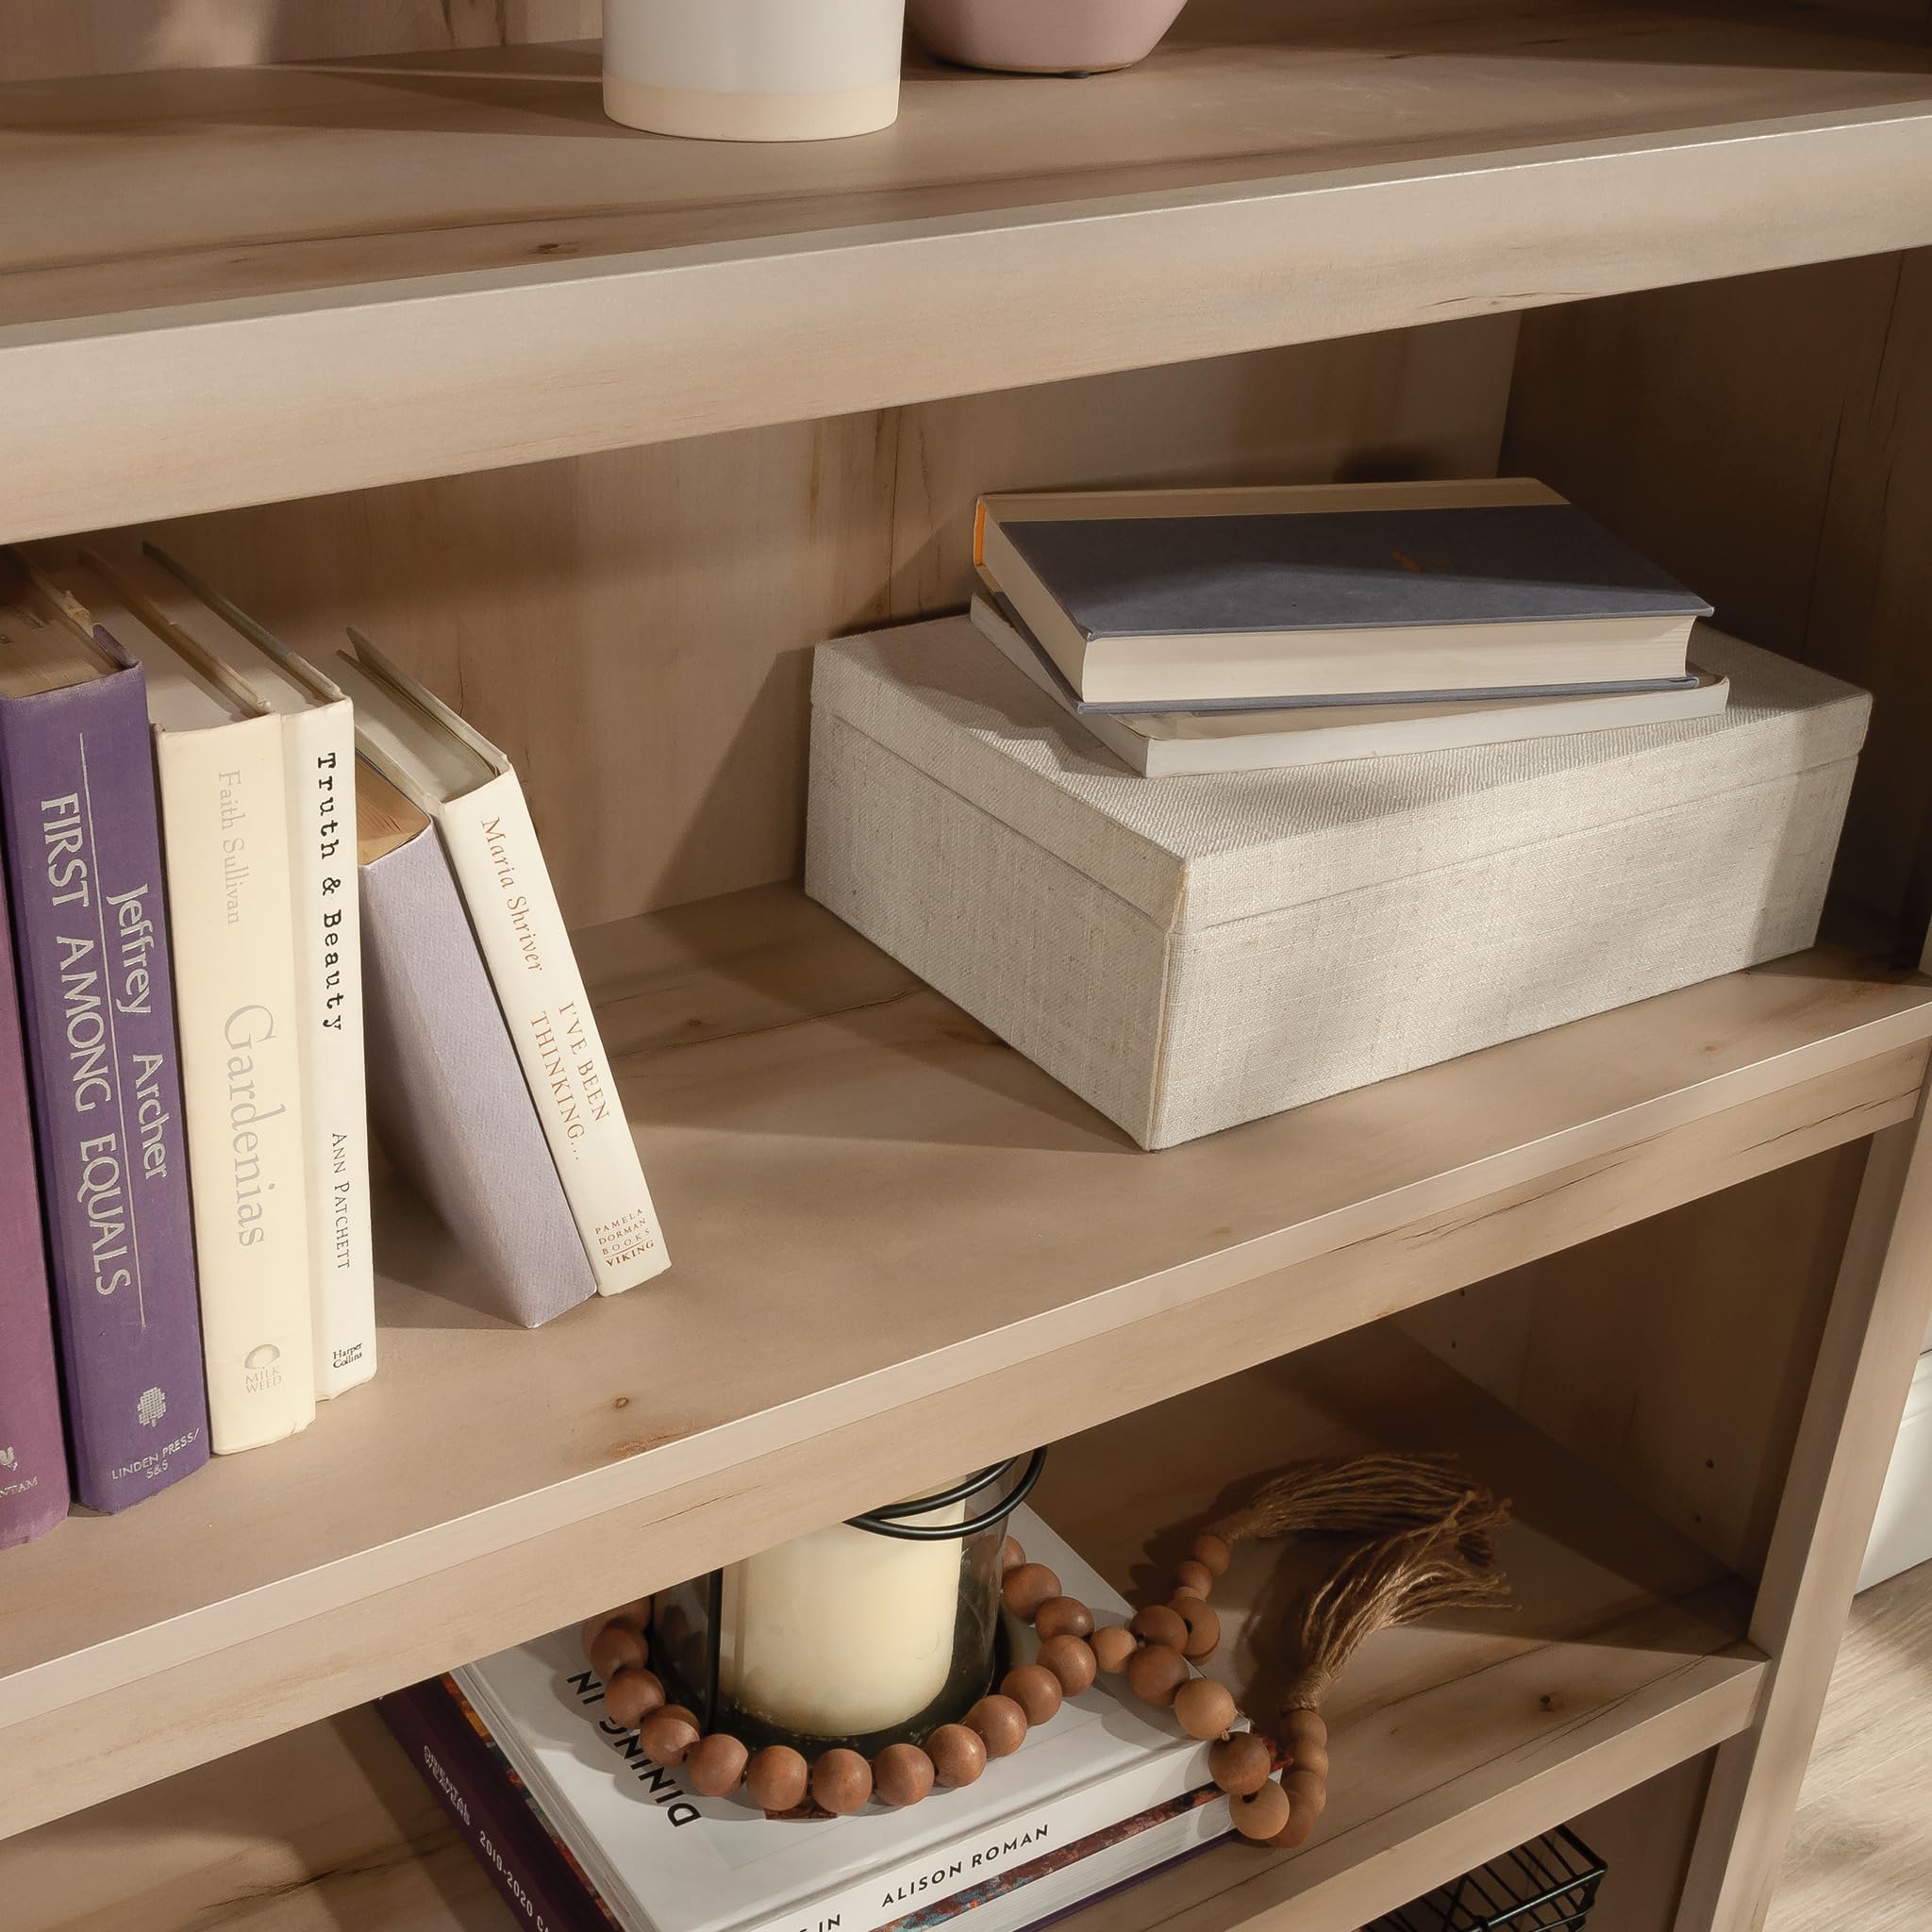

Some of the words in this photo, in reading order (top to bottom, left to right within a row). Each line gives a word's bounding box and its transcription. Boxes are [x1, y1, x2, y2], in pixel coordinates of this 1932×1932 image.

[218, 770, 246, 830] Faith
[318, 752, 339, 859] Truth
[41, 792, 90, 907] FIRST
[223, 837, 249, 924] Sullivan
[322, 876, 341, 896] &
[480, 817, 515, 890] Maria
[507, 895, 544, 973] Shriver
[323, 909, 344, 1030] Beauty
[57, 936, 111, 1113] AMONG
[106, 883, 154, 1014] Jeffrey
[132, 1053, 170, 1180] Archer
[577, 1059, 610, 1123] BEEN
[225, 1004, 287, 1247] Gardenias
[331, 1133, 347, 1174] ANN
[76, 1133, 131, 1296] EQUALS
[334, 1181, 350, 1269] PATCHETT
[594, 1208, 642, 1235] PAMELA
[598, 1217, 646, 1245] DORMAN
[602, 1227, 650, 1256] BOOKS
[606, 1240, 654, 1267] VIKING
[332, 1342, 363, 1359] Harper
[332, 1351, 363, 1369] Collins
[245, 1375, 282, 1394] WEED
[111, 1453, 159, 1480] LINDEN
[162, 1428, 201, 1458] PRESS/
[145, 1458, 169, 1479] S&S
[881, 1862, 964, 1908] ALISON
[971, 1824, 1050, 1869] ROMAN
[818, 1913, 841, 1932] IN
